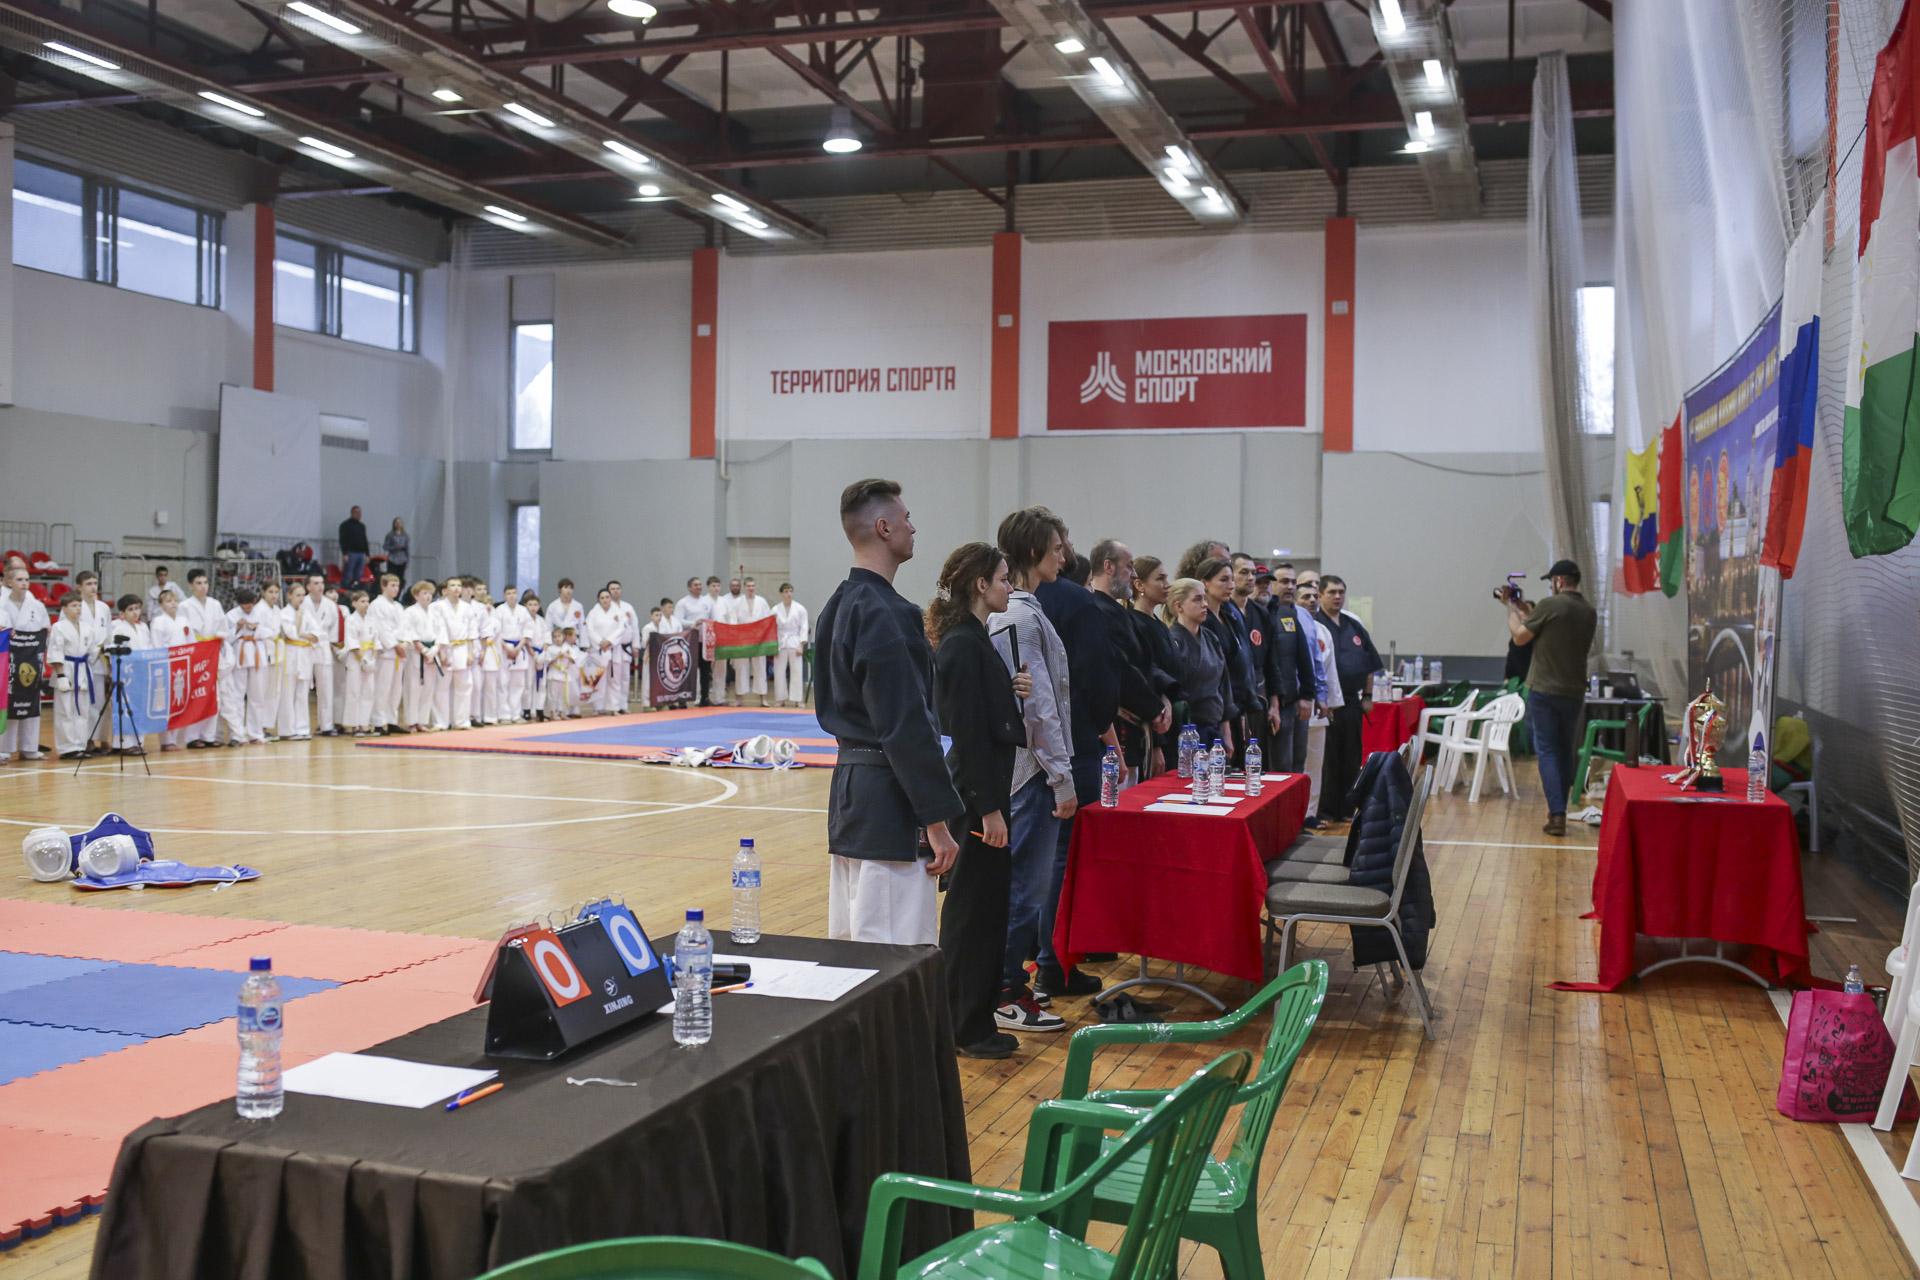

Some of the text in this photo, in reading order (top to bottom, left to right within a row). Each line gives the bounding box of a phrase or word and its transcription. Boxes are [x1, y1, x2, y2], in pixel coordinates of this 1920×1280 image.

[1135, 341, 1273, 376] МОСКОВСКИЙ
[771, 366, 956, 395] ТЕРРИТОРИЯ СПОРТА
[1134, 376, 1199, 404] СПОРТ
[603, 994, 634, 1015] XINJING
